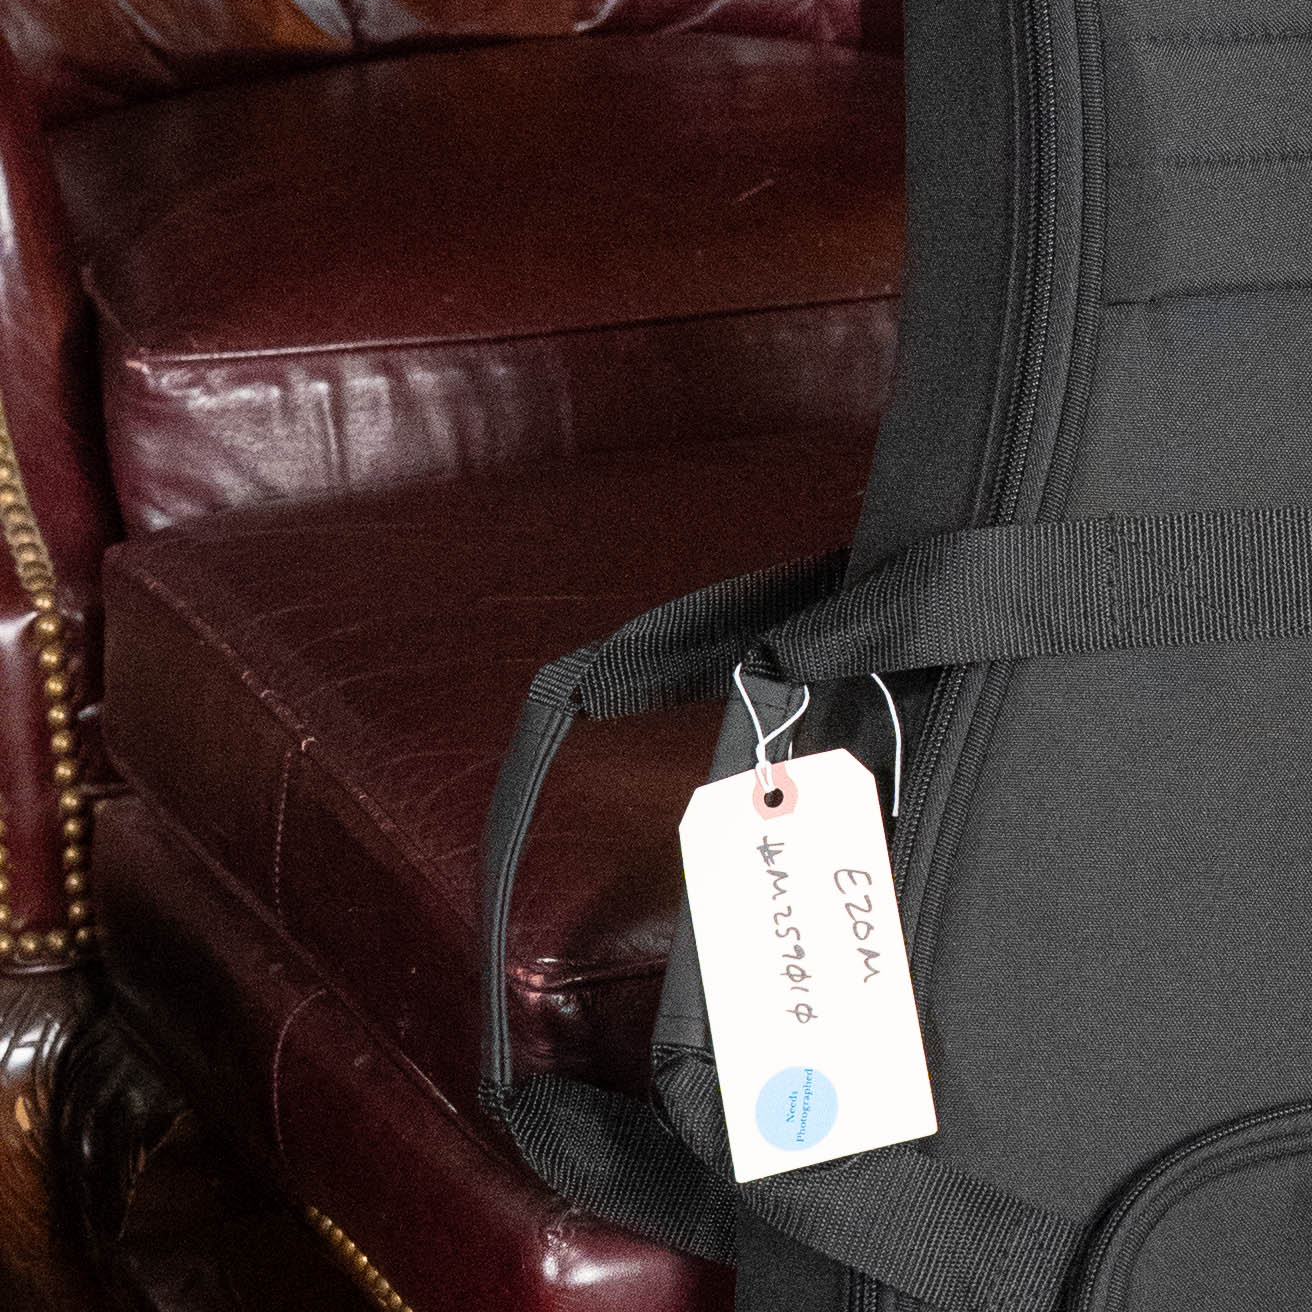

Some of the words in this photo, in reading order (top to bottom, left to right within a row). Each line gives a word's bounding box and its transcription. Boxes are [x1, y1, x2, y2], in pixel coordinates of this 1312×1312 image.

[833, 868, 880, 983] E20M
[785, 1090, 798, 1123] Needs
[796, 1068, 814, 1143] Photographed
